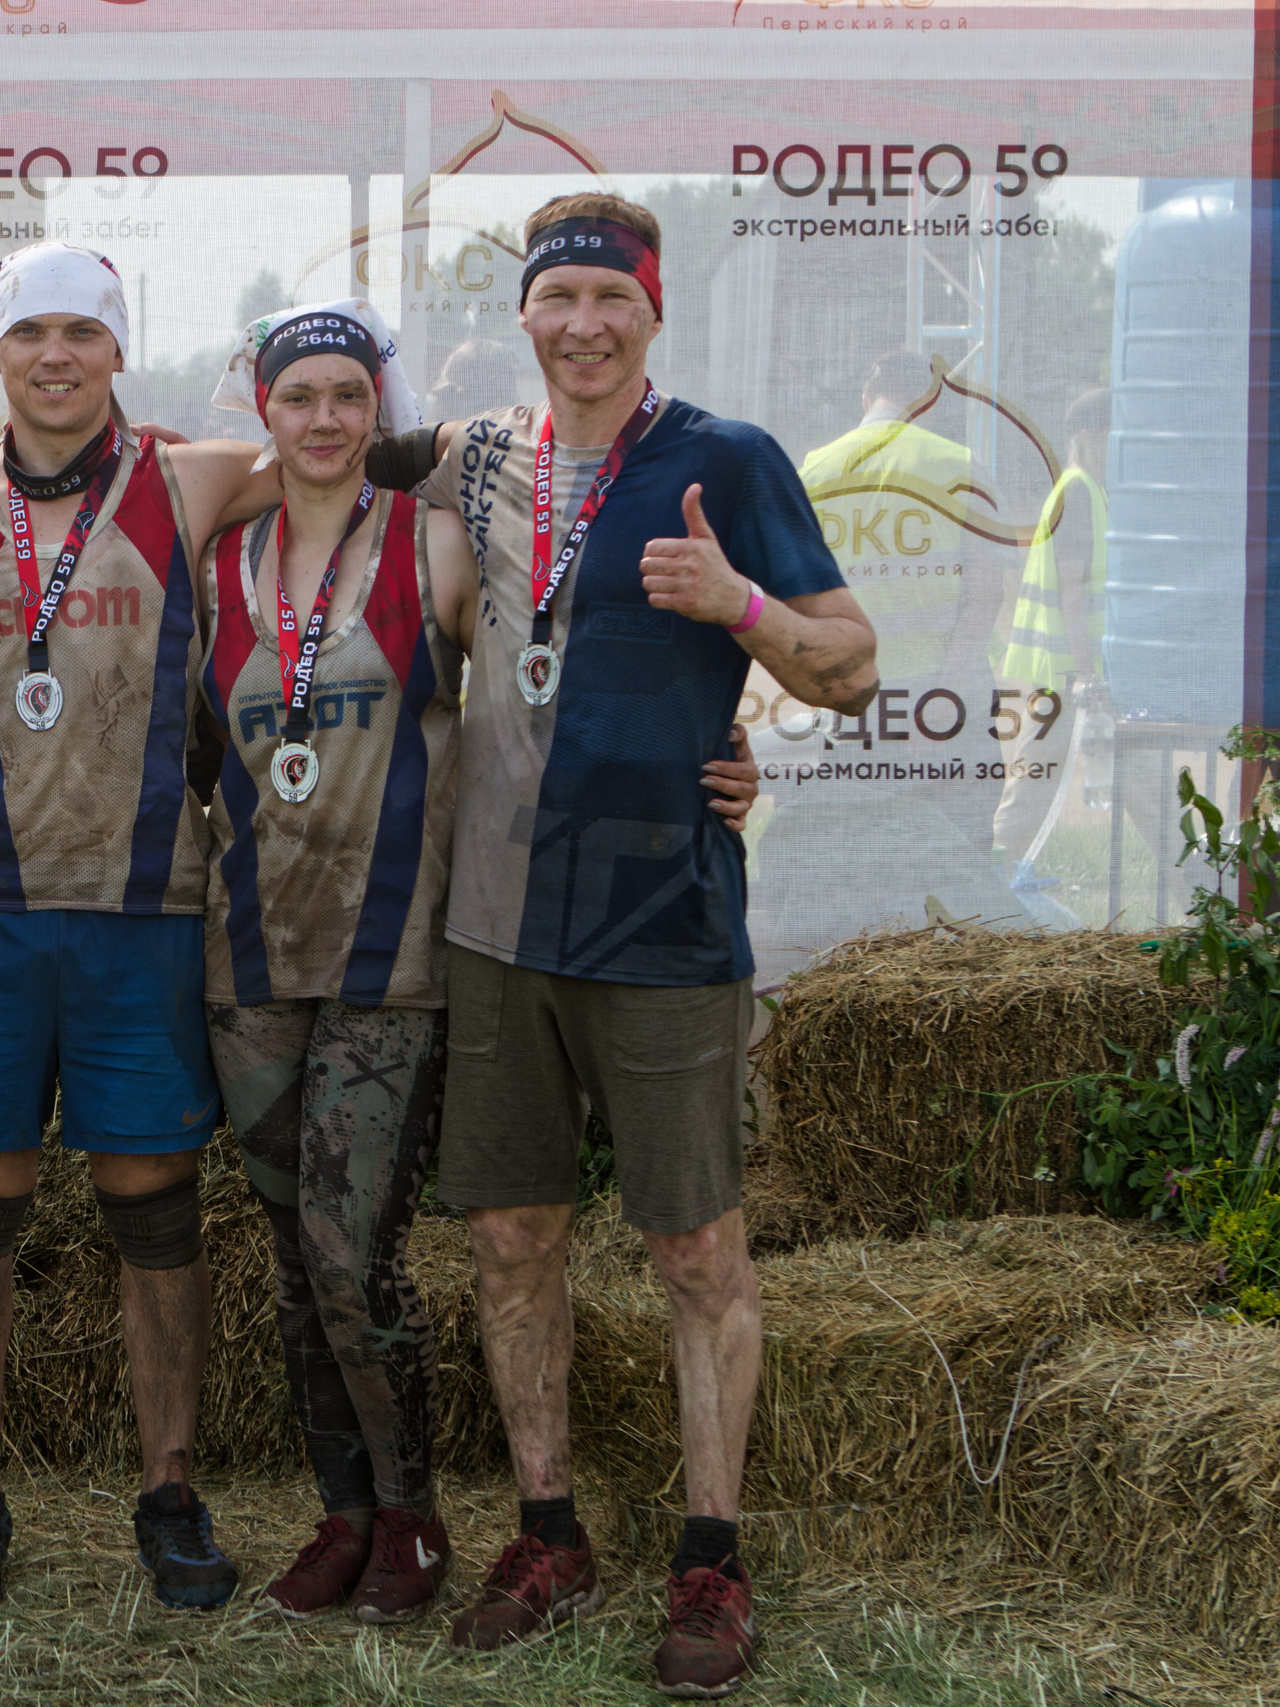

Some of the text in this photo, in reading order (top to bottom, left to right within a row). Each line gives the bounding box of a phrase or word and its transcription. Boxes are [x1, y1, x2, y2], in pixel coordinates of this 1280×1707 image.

[6, 22, 68, 37] край
[763, 16, 968, 33] Пермский край
[95, 146, 169, 200] 59
[732, 143, 1069, 206] РОДЕО 59
[81, 216, 166, 239] забег
[573, 235, 602, 248] 59
[732, 213, 1065, 242] экстремальный забег
[273, 318, 366, 347] РОДЕО 59
[296, 332, 348, 348] 2644
[61, 474, 82, 492] 59
[535, 441, 551, 535] РОДЕО 59
[9, 487, 32, 561] ОДЕО 59
[537, 520, 589, 612] РОДЕО 59
[901, 563, 963, 578] край
[31, 552, 76, 642] РОДЕО 59
[281, 609, 295, 632] 59
[292, 613, 324, 709] РОДЕО 59
[238, 691, 388, 745] АОТ
[987, 687, 1063, 741] 59
[756, 758, 1058, 785] стремальный забег
